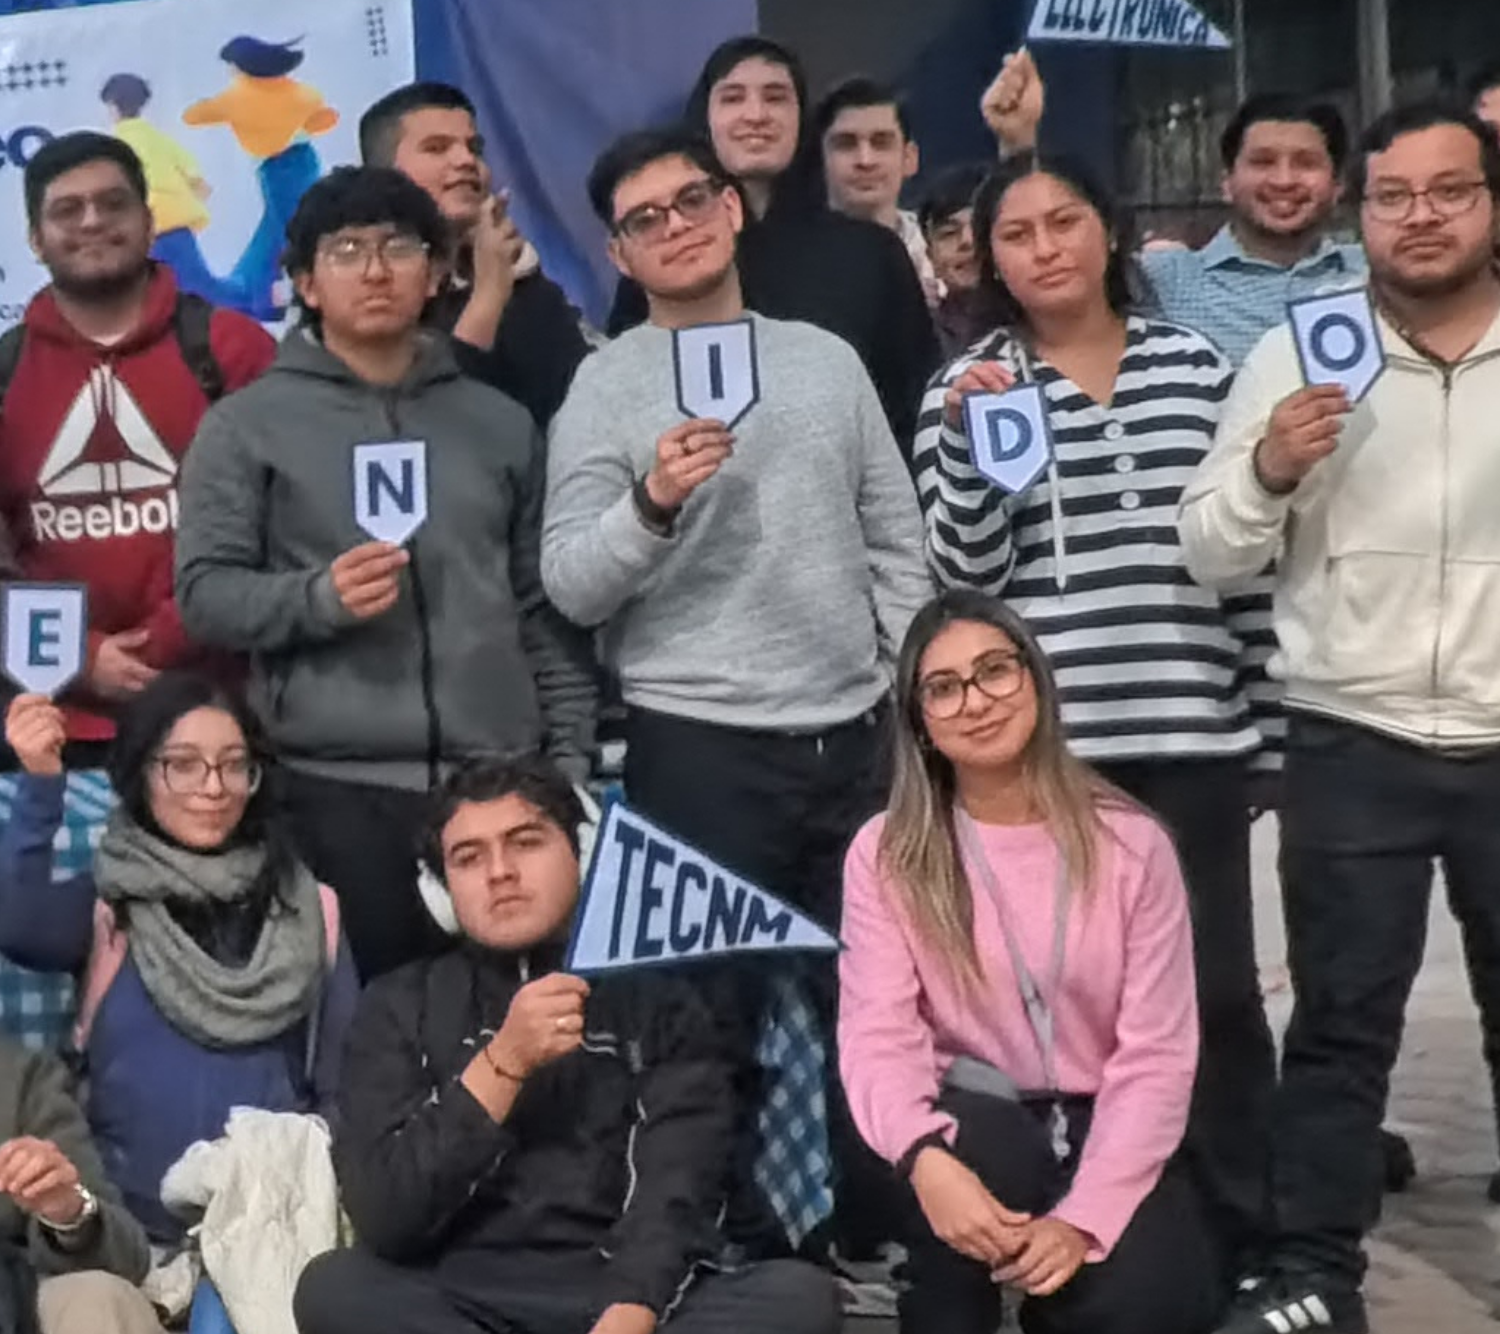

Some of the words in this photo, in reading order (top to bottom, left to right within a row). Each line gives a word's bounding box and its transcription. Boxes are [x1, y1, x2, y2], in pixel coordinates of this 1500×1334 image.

[1309, 312, 1366, 370] O
[709, 343, 725, 400] I
[985, 408, 1033, 462] D
[367, 459, 414, 517] N
[28, 609, 61, 666] E
[608, 819, 793, 961] TECNM
